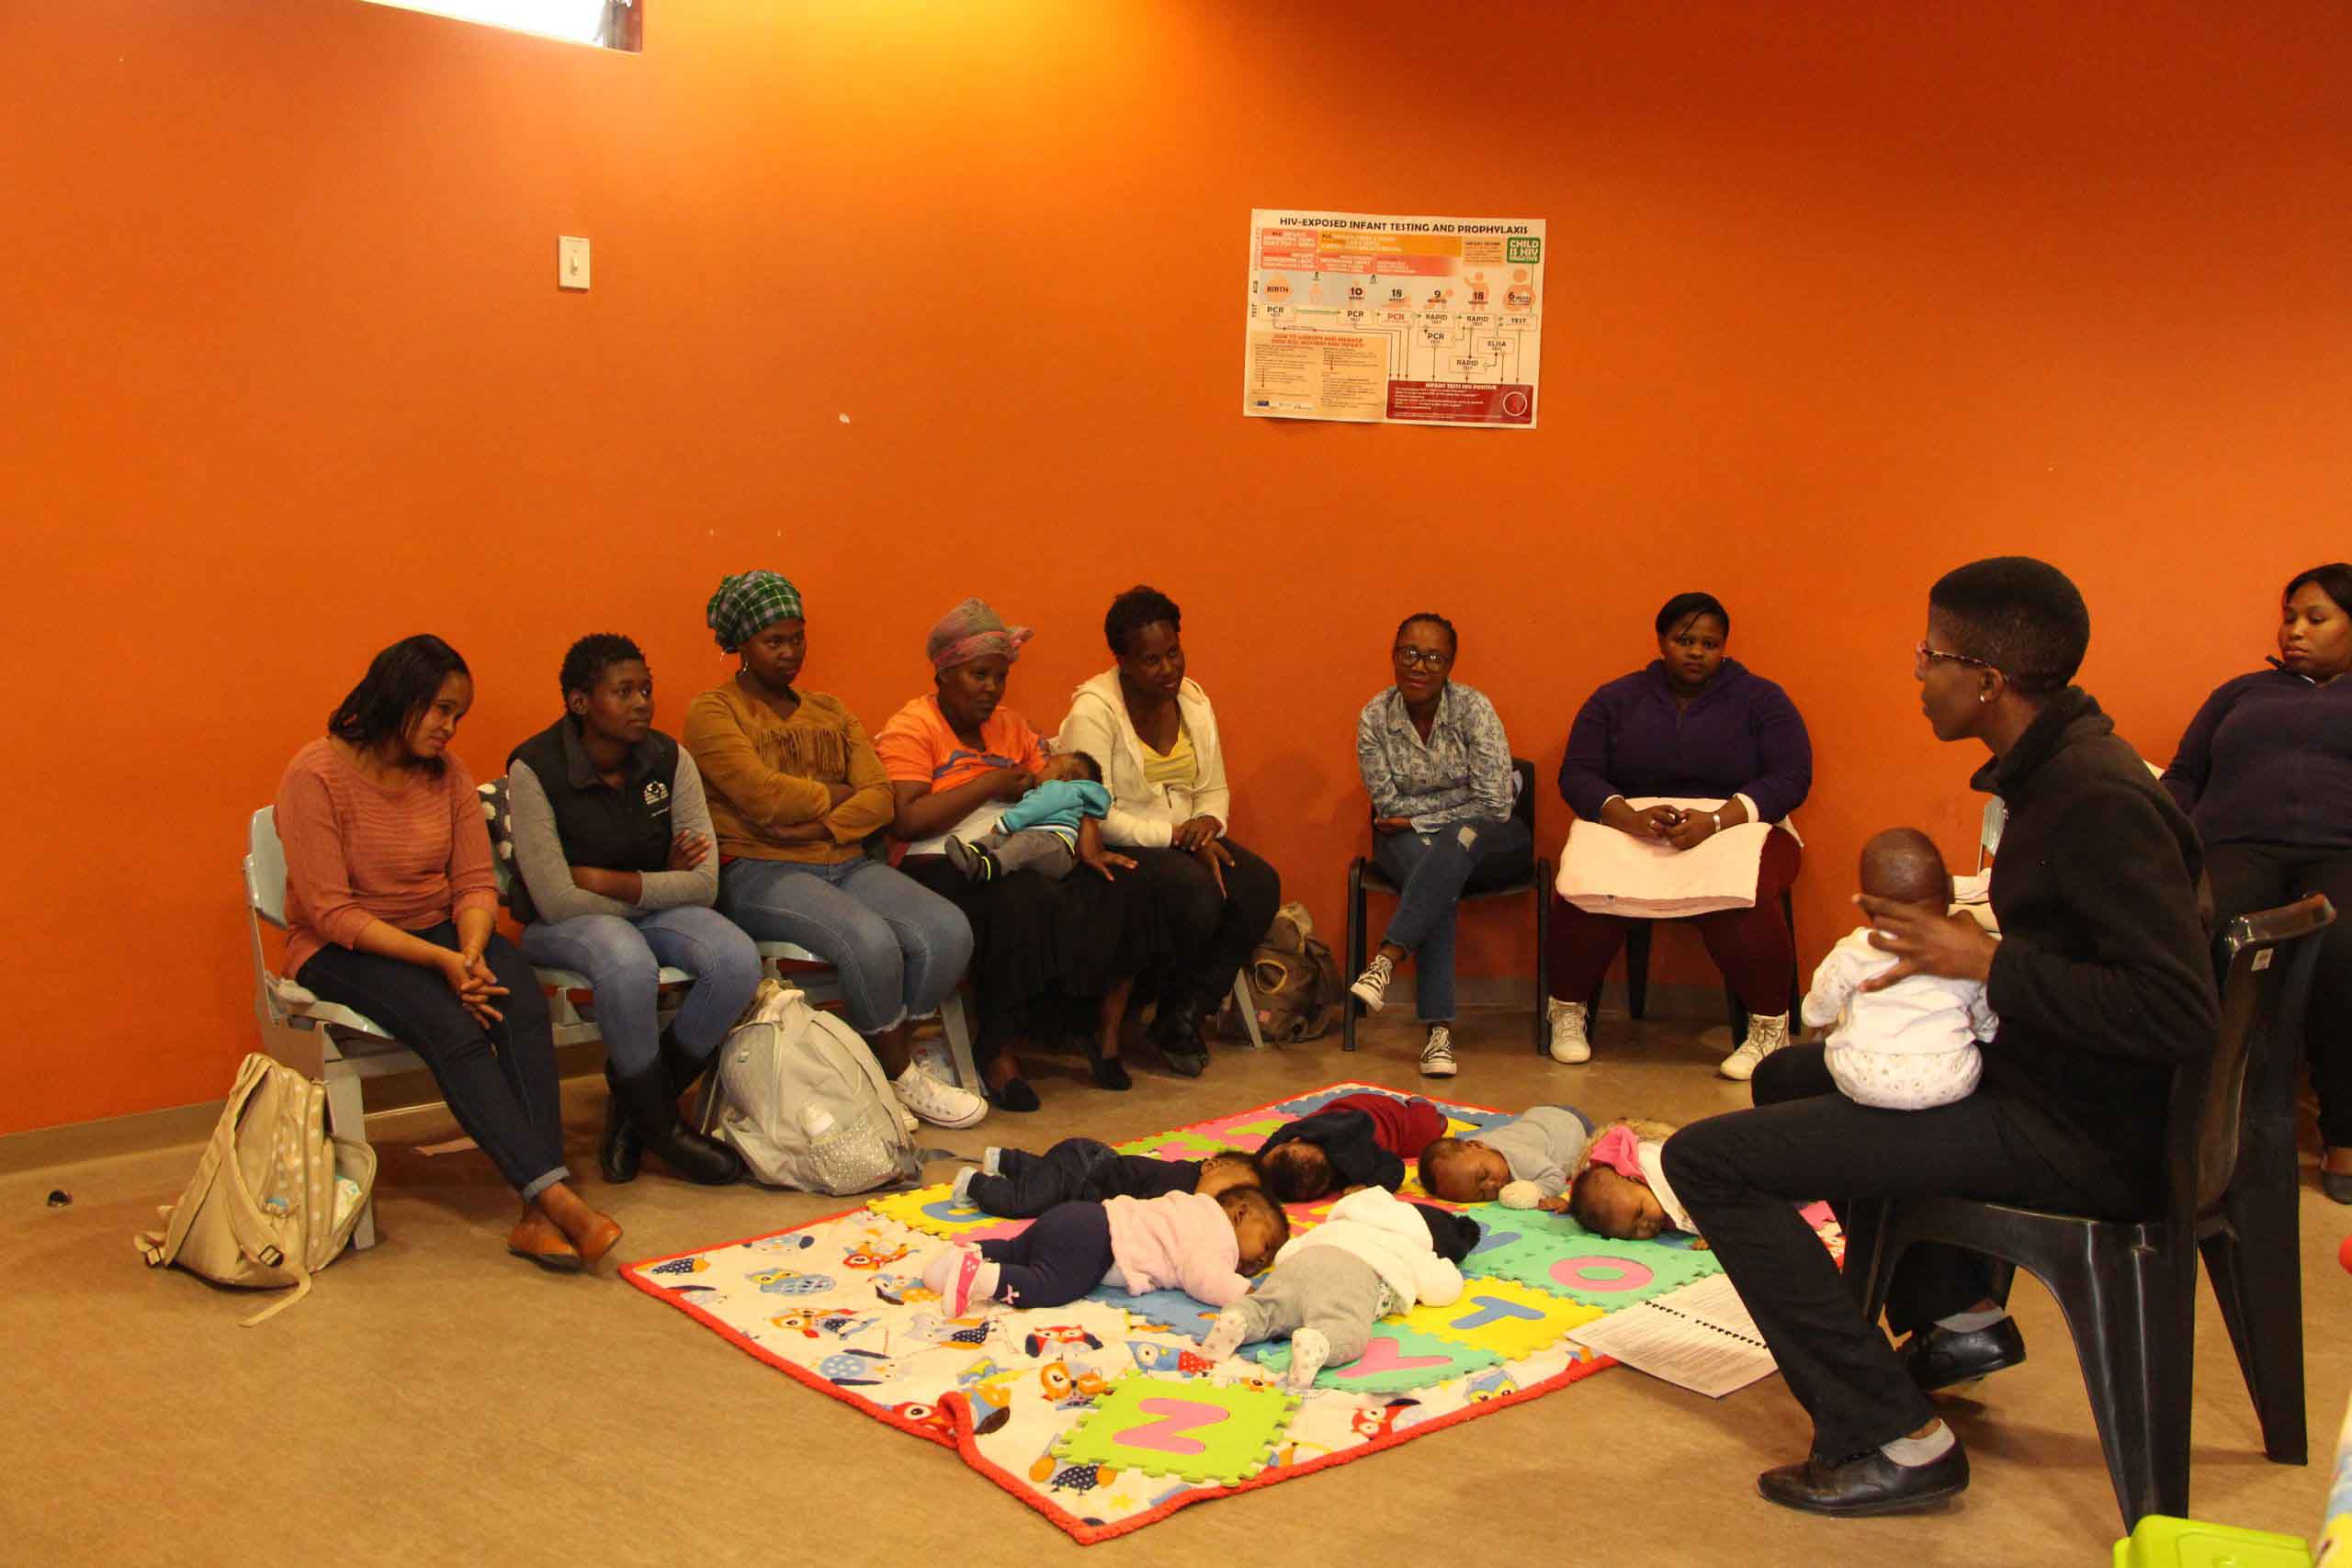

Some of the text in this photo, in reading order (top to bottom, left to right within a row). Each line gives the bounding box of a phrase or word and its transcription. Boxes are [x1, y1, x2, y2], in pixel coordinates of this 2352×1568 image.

[1280, 217, 1529, 235] HIV-EXPOSED INFANT TESTING AND PROPHYLAXIS
[1510, 240, 1539, 248] CHILD
[1521, 248, 1538, 257] HIV
[1266, 286, 1289, 294] BIRTH
[1351, 287, 1363, 297] 10
[1391, 288, 1403, 299] 18
[1433, 289, 1442, 299] 9
[1473, 291, 1485, 301] 18
[1508, 292, 1516, 301] 6
[1266, 305, 1284, 314] PCR
[1347, 310, 1365, 319] PCR
[1386, 312, 1405, 321] PCR
[1425, 313, 1448, 321] RAPID
[1466, 315, 1489, 323] RAPID
[1510, 317, 1527, 325] TEST
[1427, 332, 1445, 341] PCR
[1487, 340, 1508, 348] ELISA
[1456, 359, 1479, 367] RAPID
[1549, 1256, 1654, 1292] O
[1450, 1296, 1546, 1329] T
